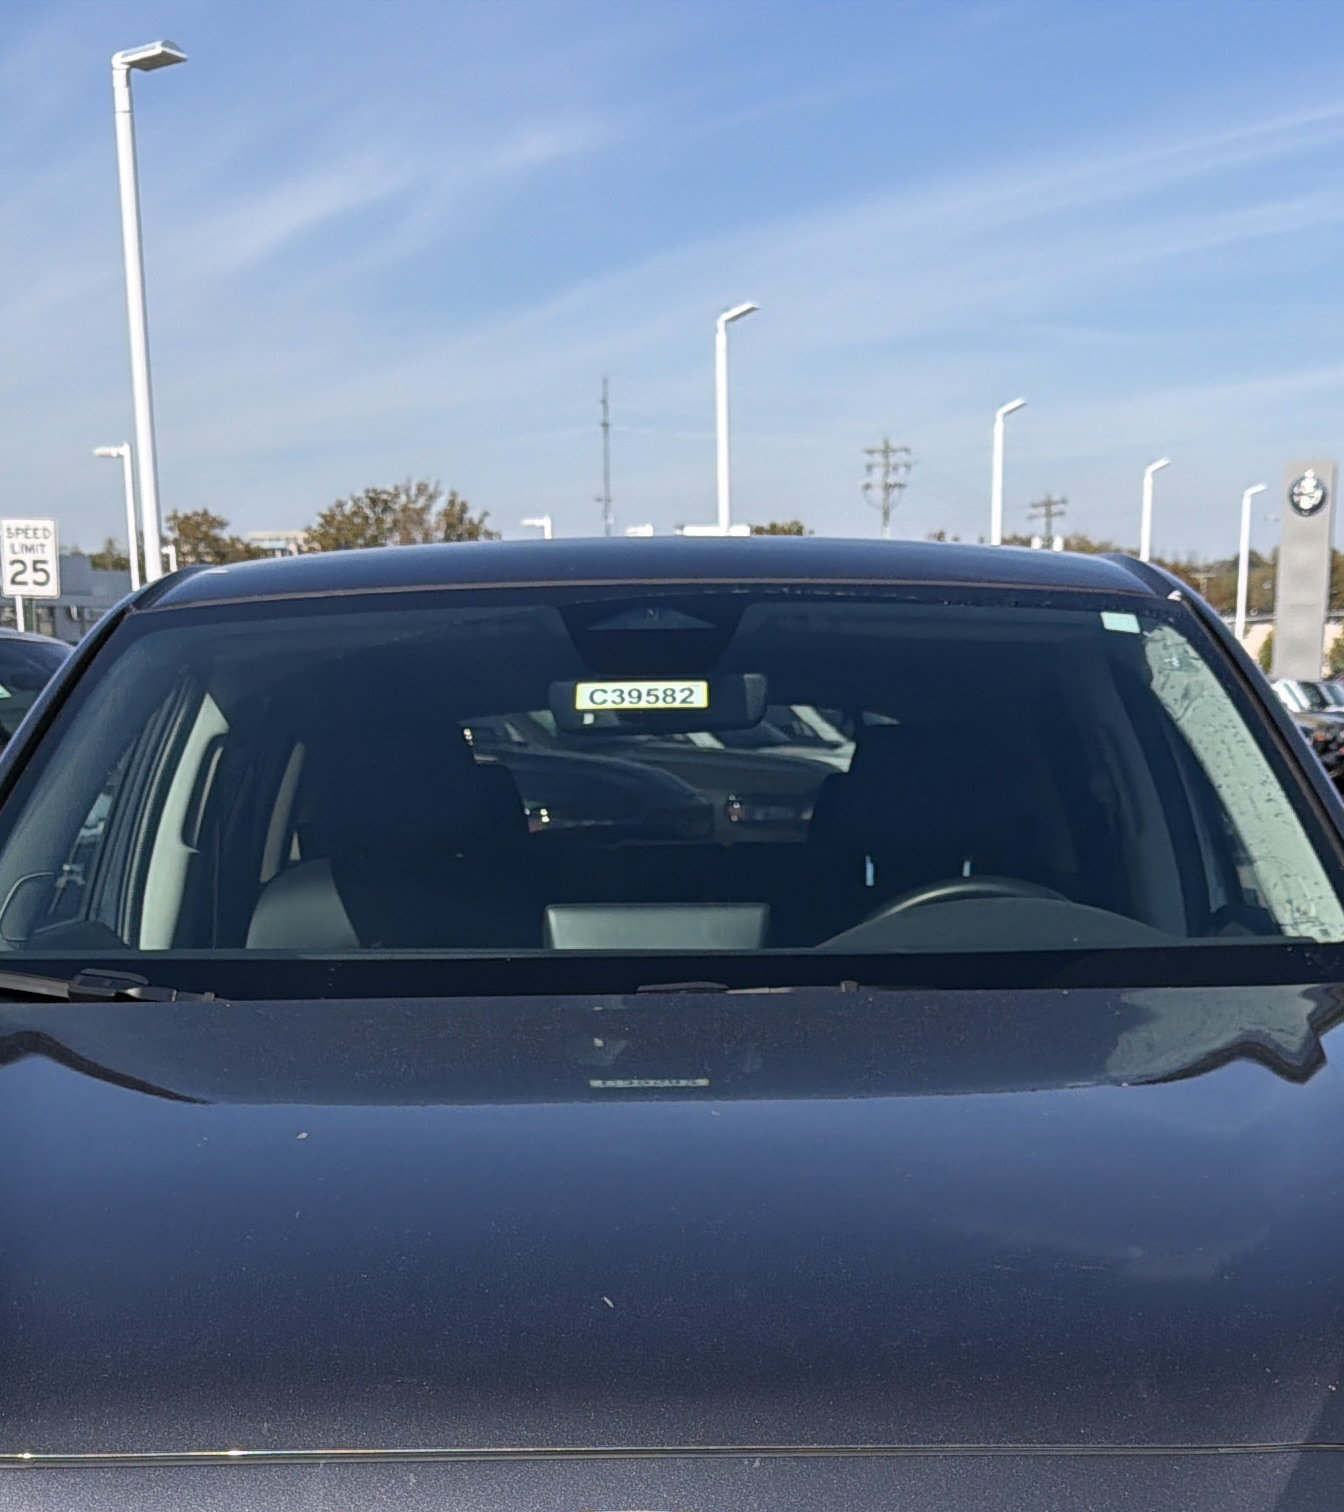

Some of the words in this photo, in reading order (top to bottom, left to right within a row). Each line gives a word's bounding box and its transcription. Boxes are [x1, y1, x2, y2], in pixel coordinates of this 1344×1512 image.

[5, 526, 52, 540] SPEED
[9, 542, 47, 555] LIMIT
[8, 559, 51, 587] 25
[588, 687, 695, 706] C39582
